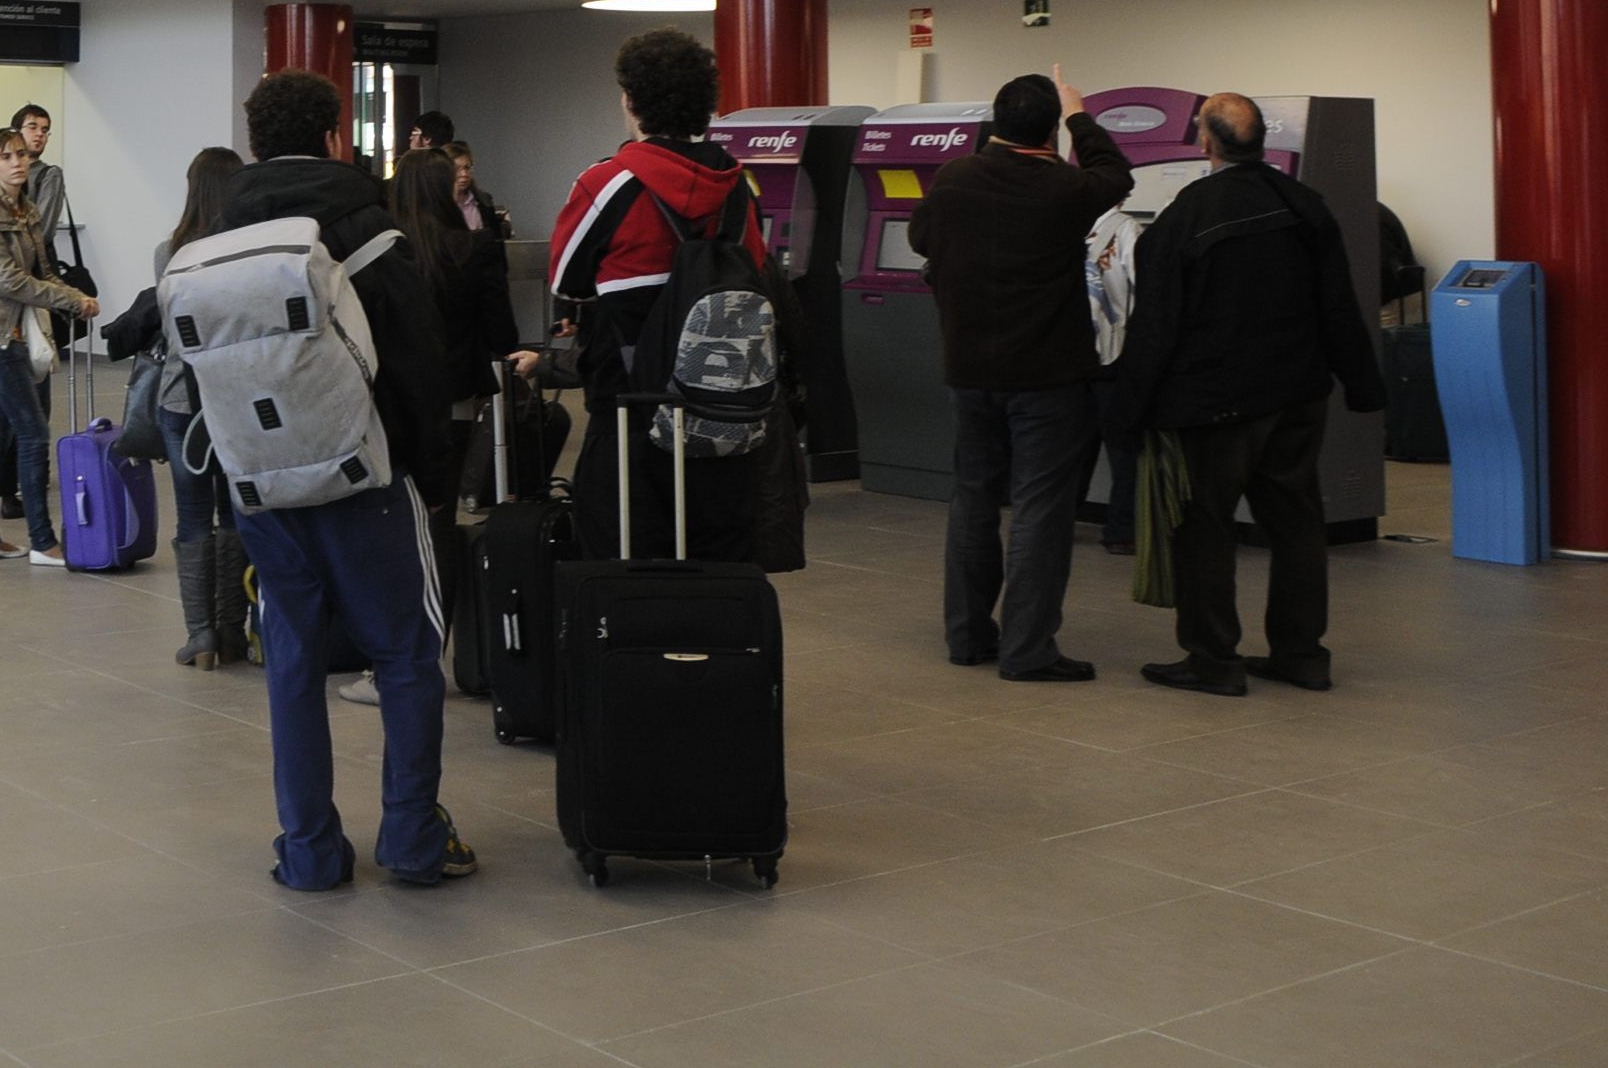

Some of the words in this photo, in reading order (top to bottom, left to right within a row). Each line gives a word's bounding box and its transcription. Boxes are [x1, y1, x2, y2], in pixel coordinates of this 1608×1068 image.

[361, 35, 382, 46] Sala
[747, 130, 798, 153] renfe
[910, 127, 969, 152] renfe
